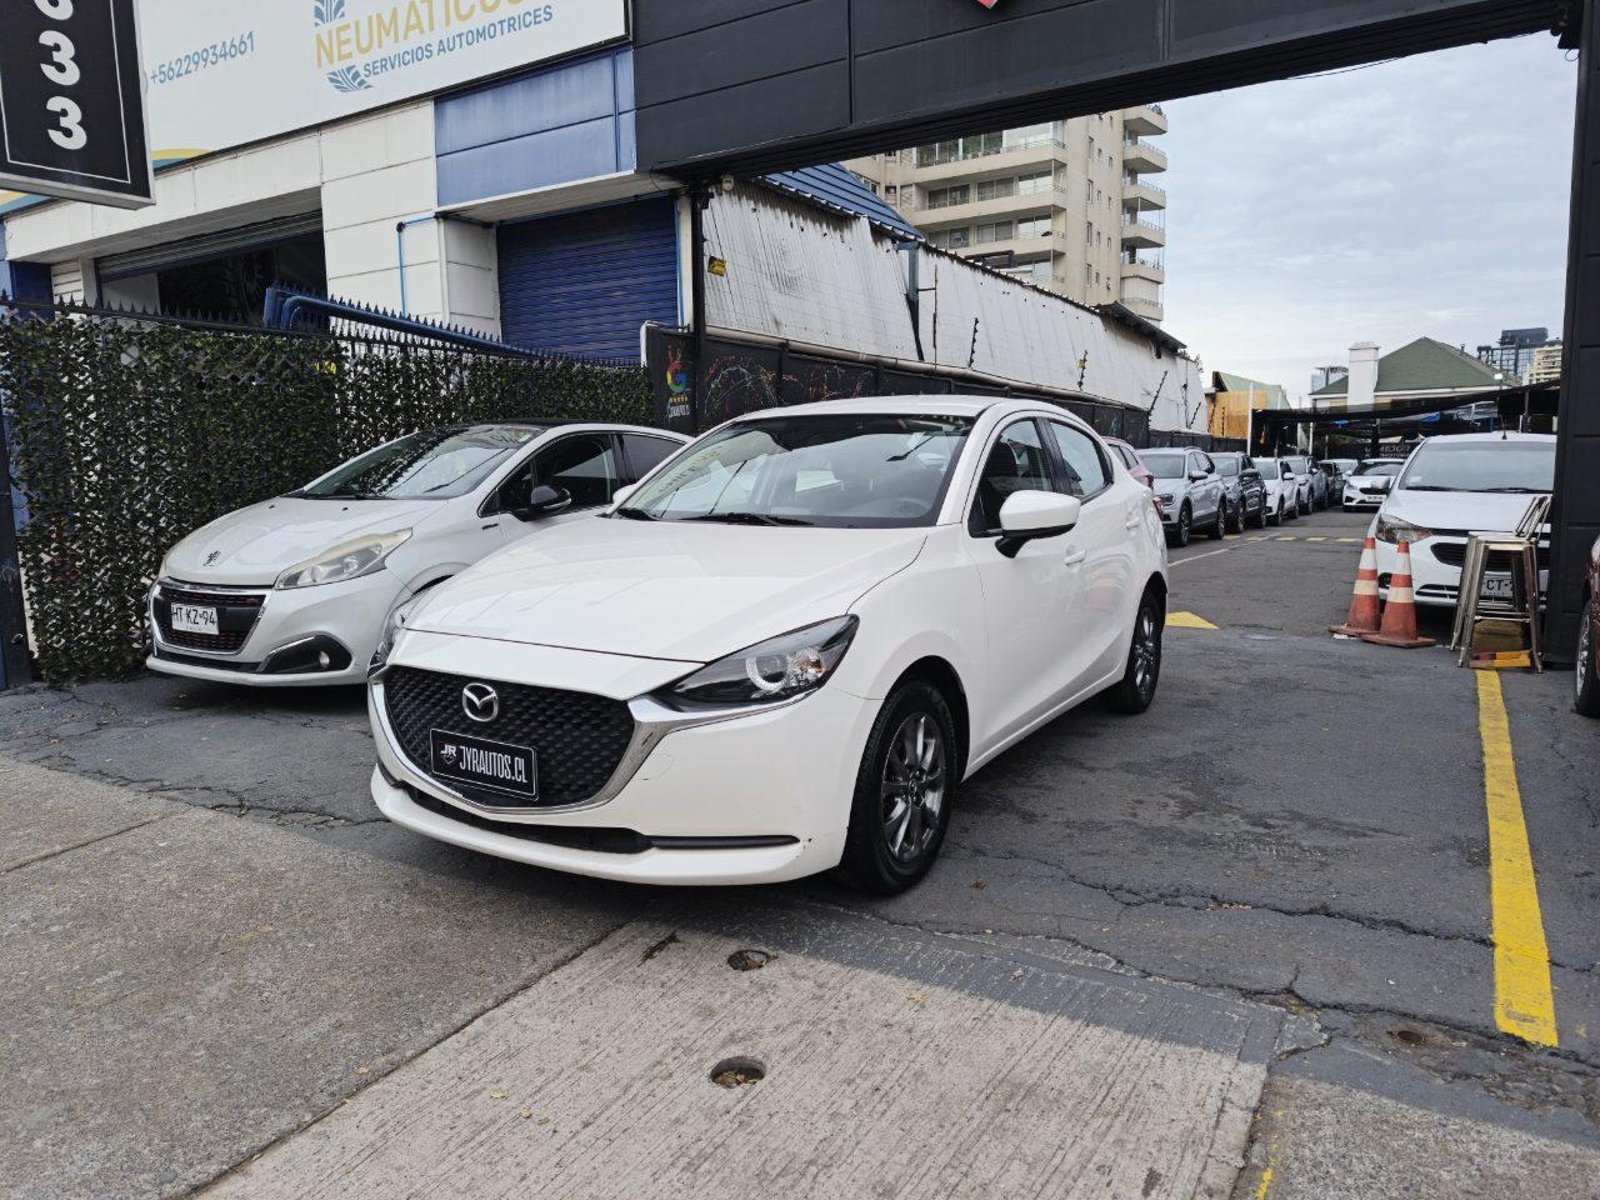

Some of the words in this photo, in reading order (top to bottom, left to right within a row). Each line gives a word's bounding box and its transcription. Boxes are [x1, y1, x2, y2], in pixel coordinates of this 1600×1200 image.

[150, 30, 255, 84] +56229934661
[363, 43, 433, 78] SERVICIOS
[437, 5, 553, 56] AUTOMOTRICES
[459, 745, 528, 783] JYRAUTOS.CL
